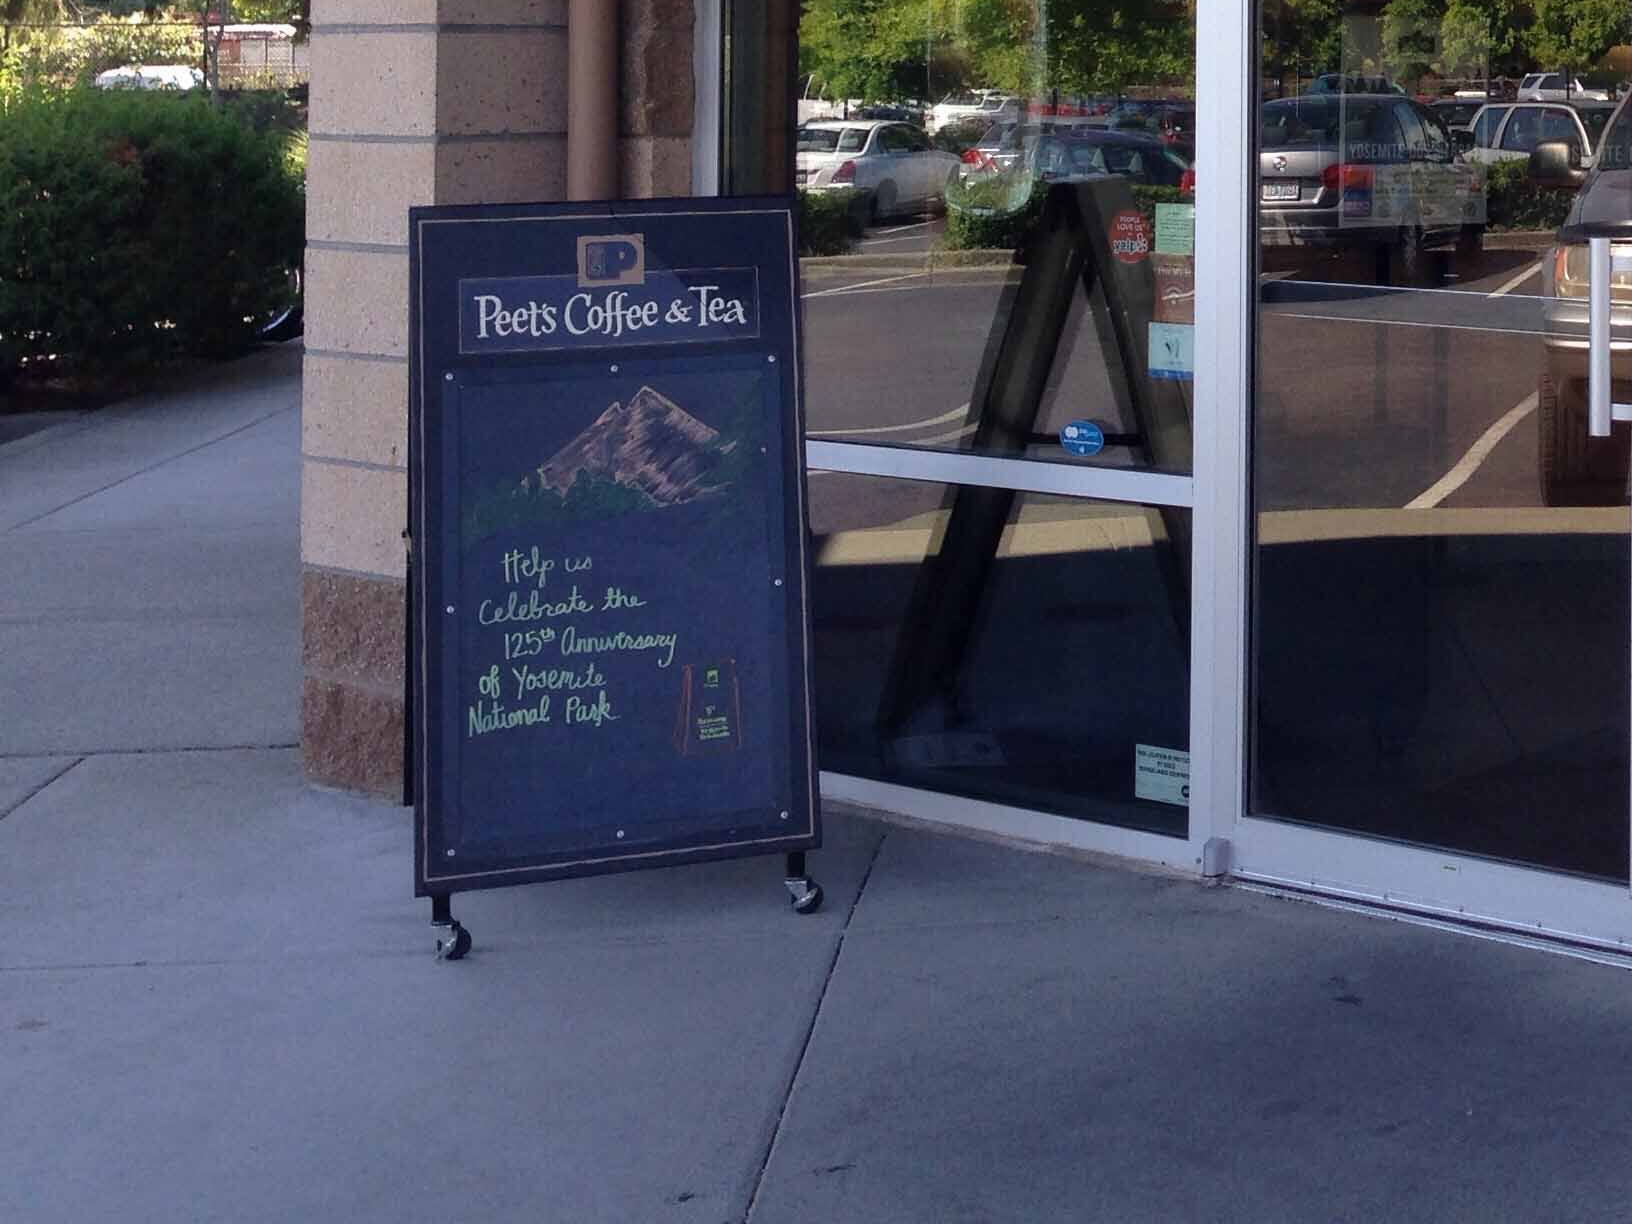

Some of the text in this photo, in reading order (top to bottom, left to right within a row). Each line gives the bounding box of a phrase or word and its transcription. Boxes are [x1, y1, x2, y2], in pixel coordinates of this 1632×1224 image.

[473, 285, 747, 338] Peet's Coffee & Tea
[500, 545, 594, 588] Help us
[479, 585, 648, 625] Celebrate the
[504, 626, 678, 668] 125th Anniversary
[479, 663, 608, 701] of Yosemite
[468, 690, 621, 737] National Park
